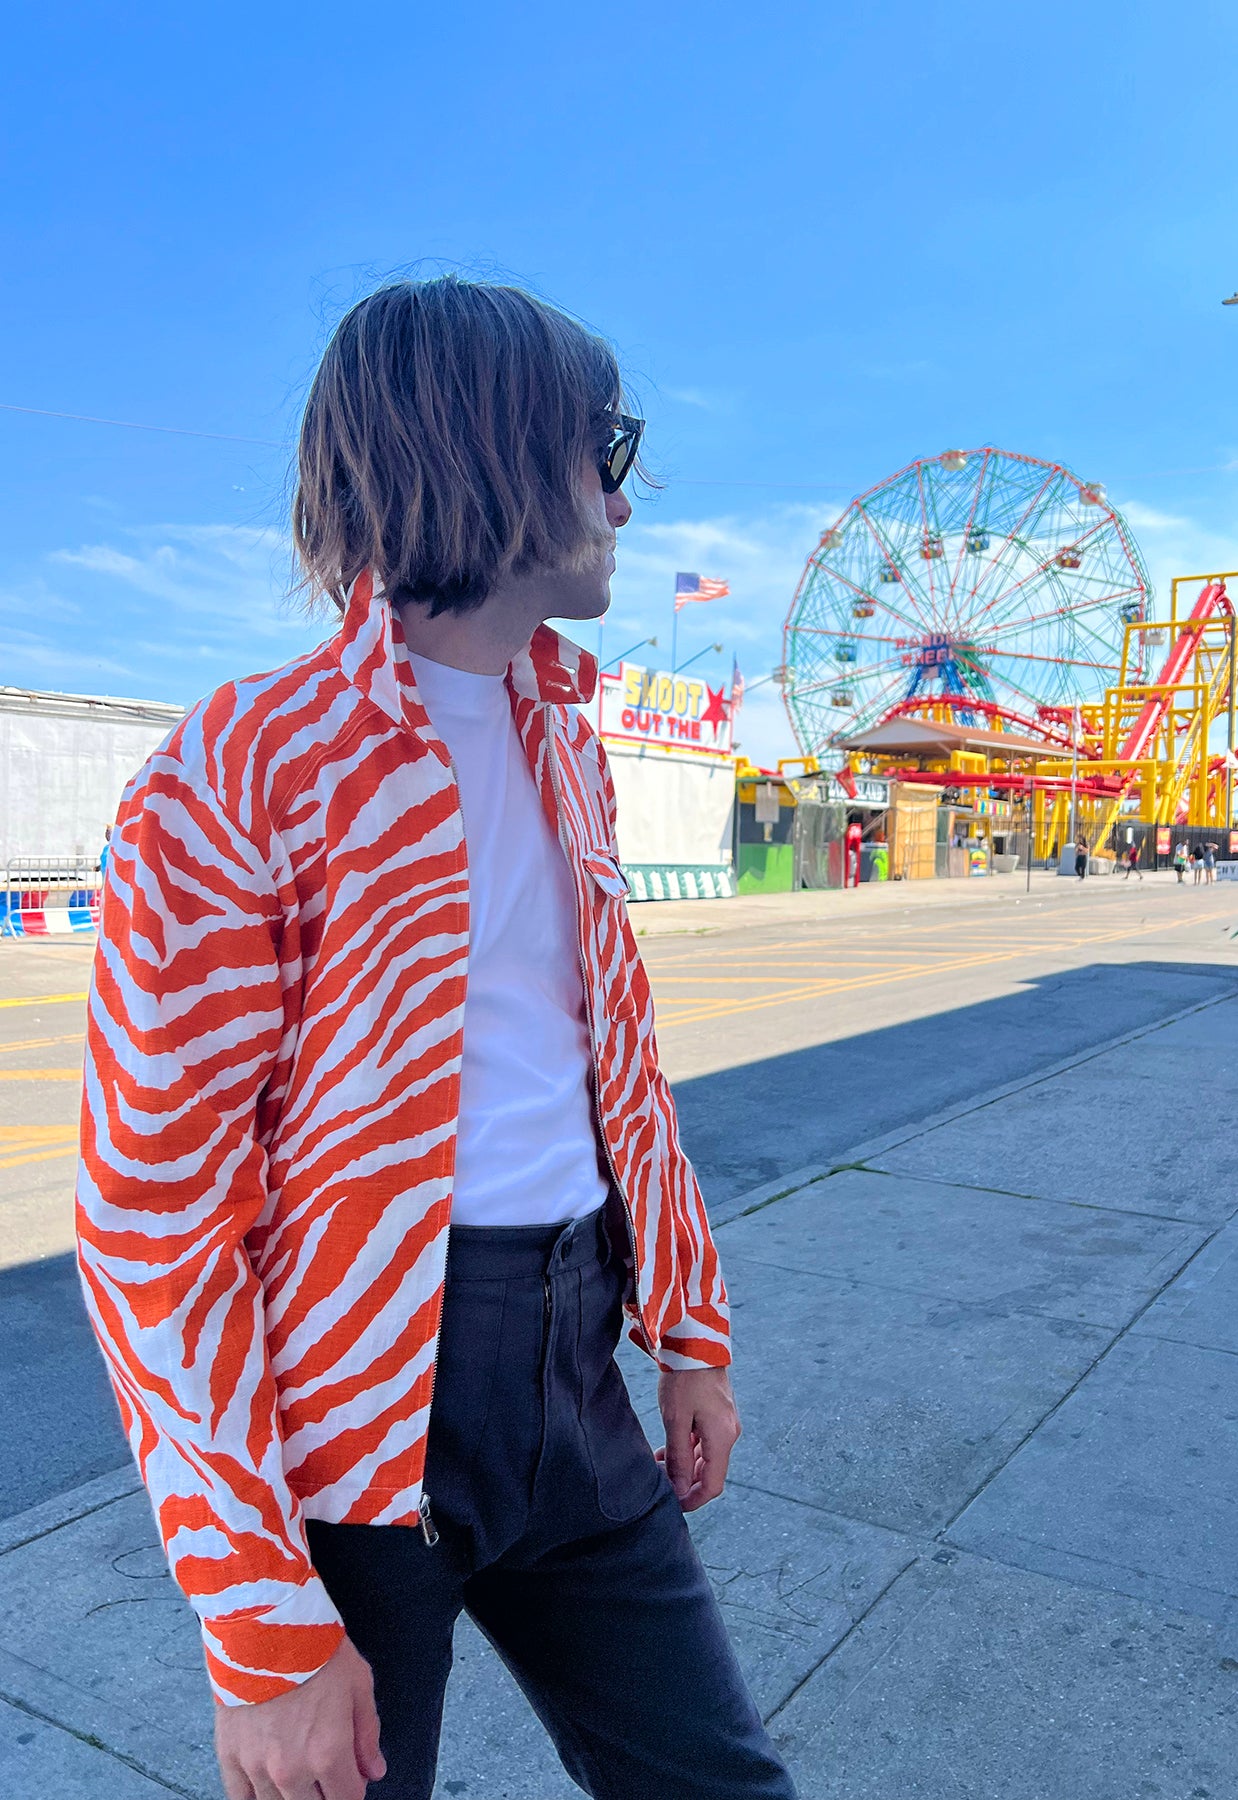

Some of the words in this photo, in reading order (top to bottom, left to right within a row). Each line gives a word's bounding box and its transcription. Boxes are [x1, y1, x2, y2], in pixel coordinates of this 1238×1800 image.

[901, 647, 954, 665] WHEEL
[625, 668, 703, 720] SHOOT
[621, 708, 663, 735] OUT
[667, 716, 702, 741] THE
